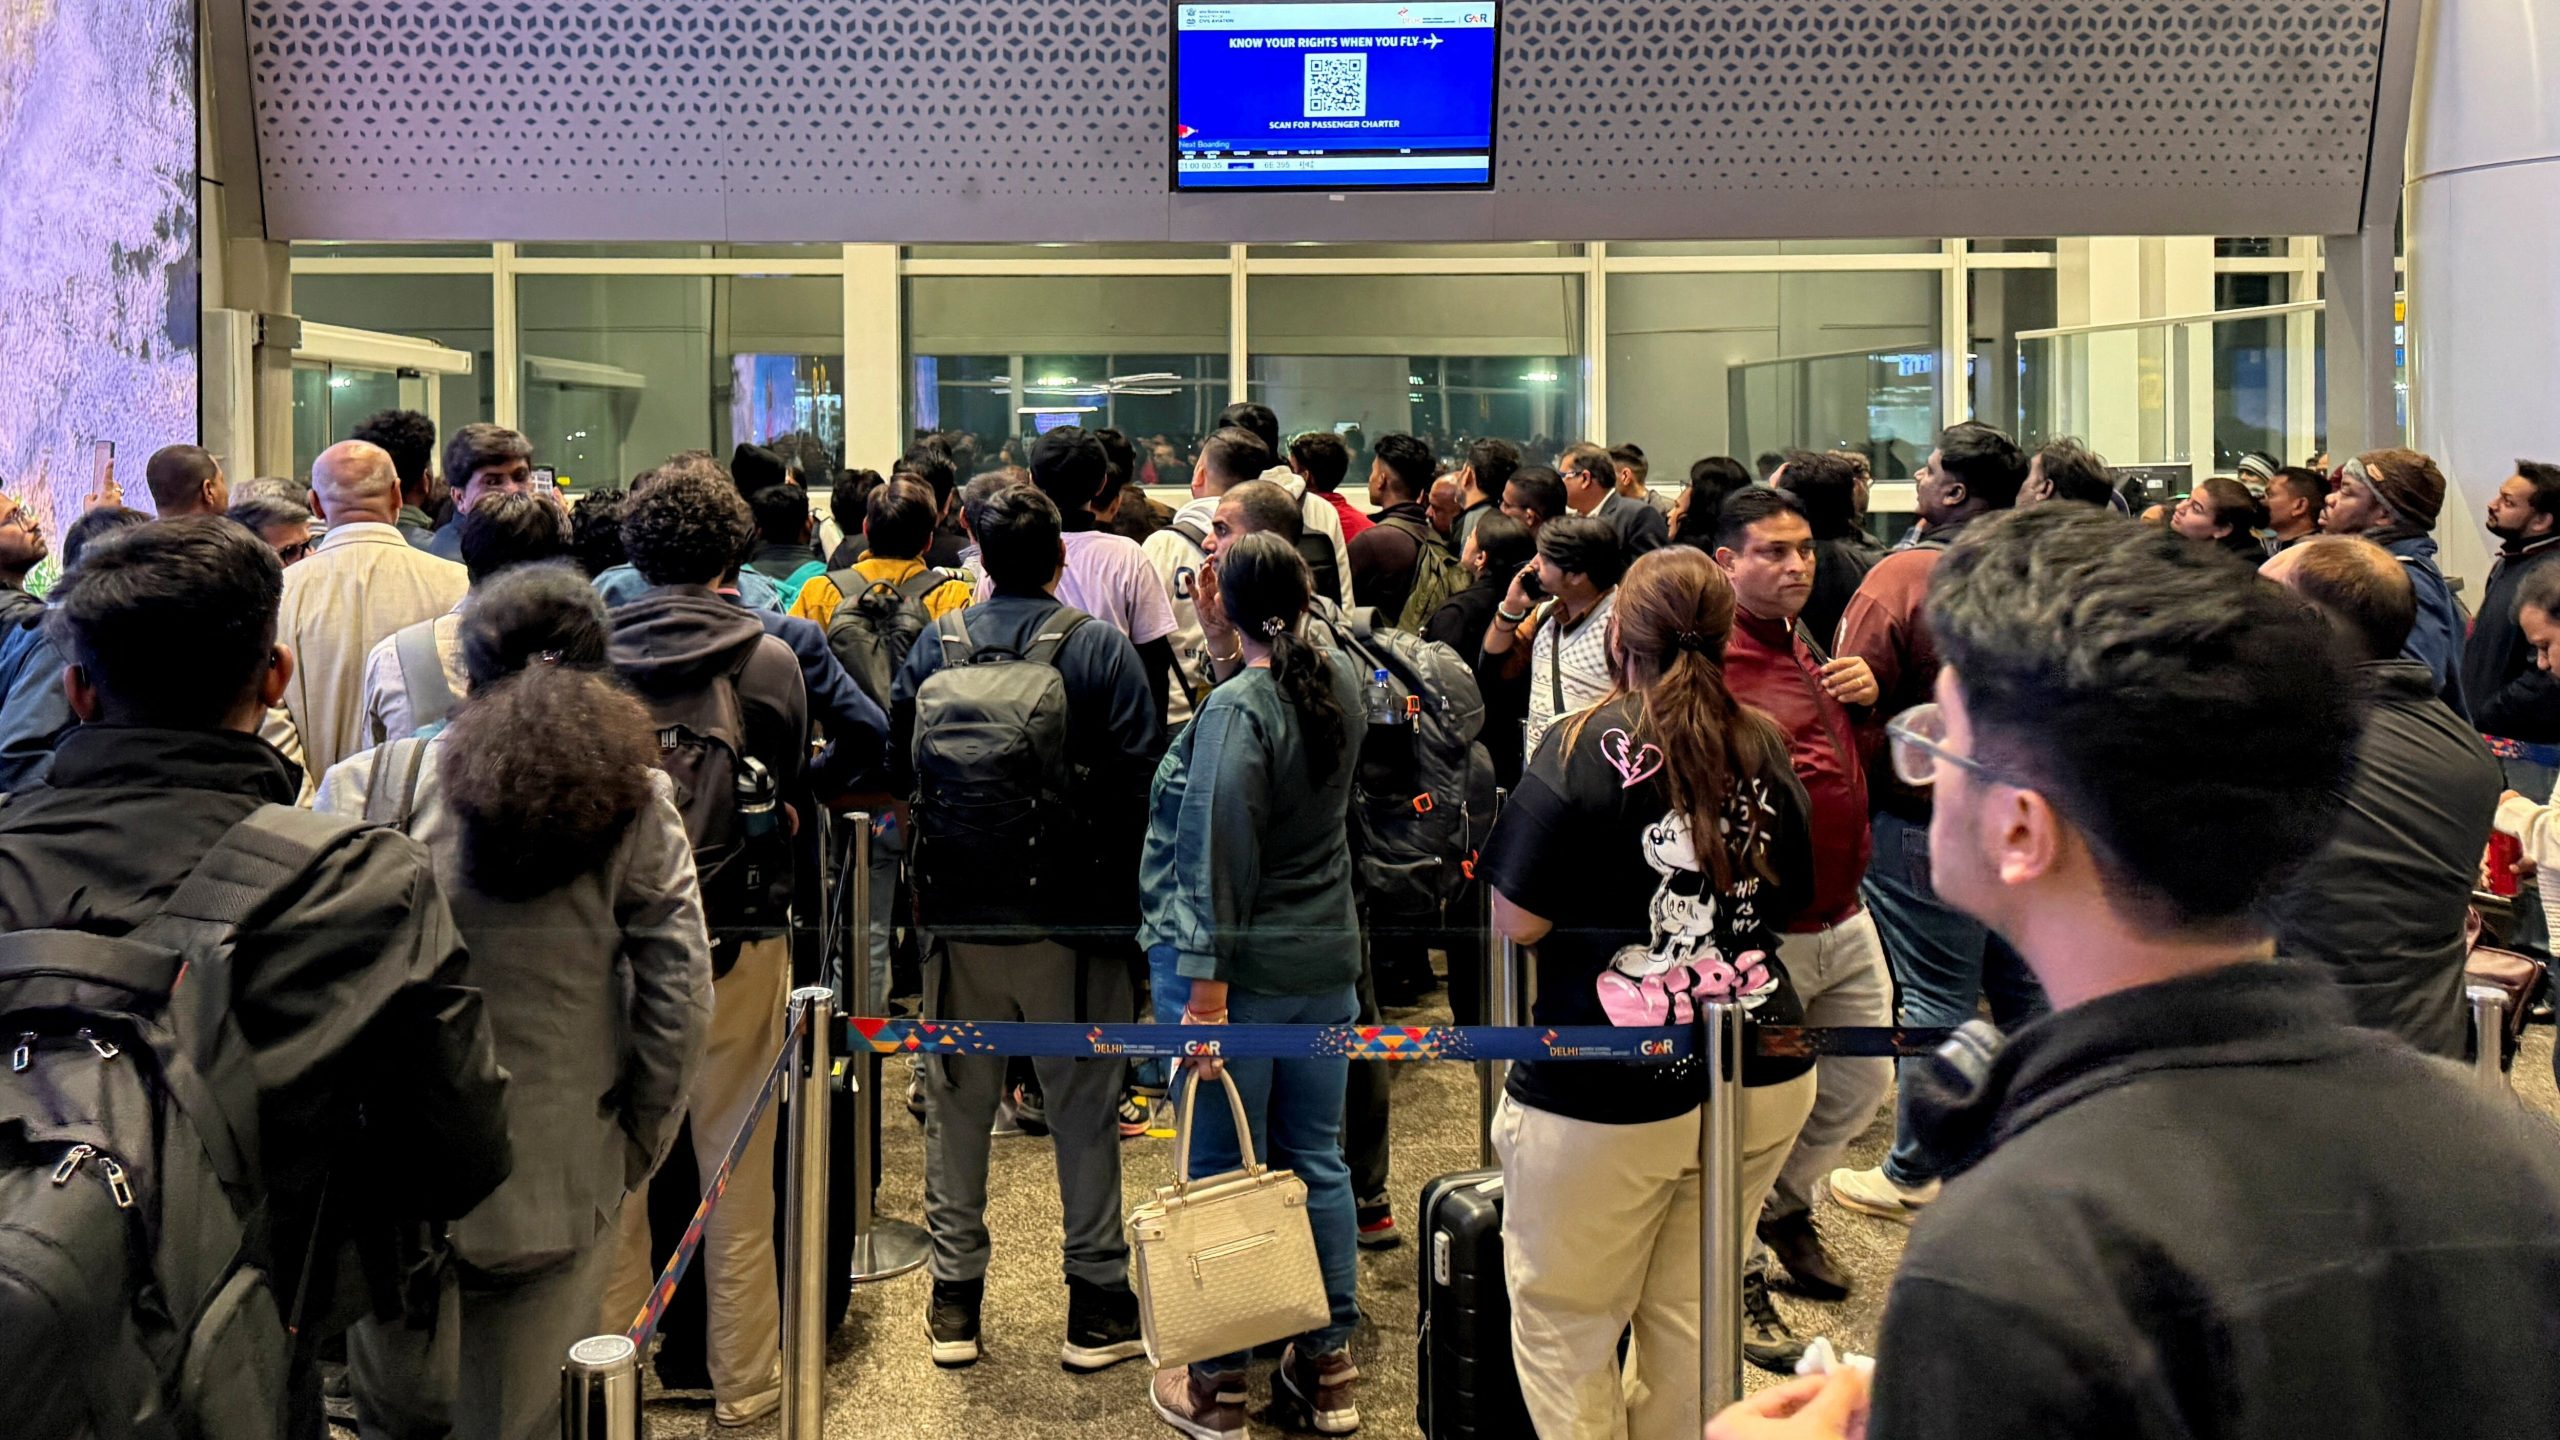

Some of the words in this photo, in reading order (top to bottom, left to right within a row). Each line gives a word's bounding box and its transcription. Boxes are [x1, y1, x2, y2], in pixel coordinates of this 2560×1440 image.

[1229, 38, 1263, 48] KNOW
[1265, 37, 1295, 48] YOUR
[1298, 37, 1338, 47] RIGHTS
[1340, 37, 1373, 47] WHEN
[1375, 36, 1398, 47] YOU
[1400, 36, 1419, 46] FLY
[1269, 121, 1291, 129] SCAN
[1293, 121, 1310, 129] FOR
[1311, 120, 1360, 129] PASSENGER
[1361, 120, 1400, 128] CHARTER
[1197, 141, 1230, 150] Boarding
[1732, 918, 1760, 935] MY
[1094, 1044, 1122, 1054] DELHI
[1185, 1040, 1221, 1056] GMR
[1550, 1046, 1579, 1056] DELHI
[1641, 1039, 1674, 1056] GMR
